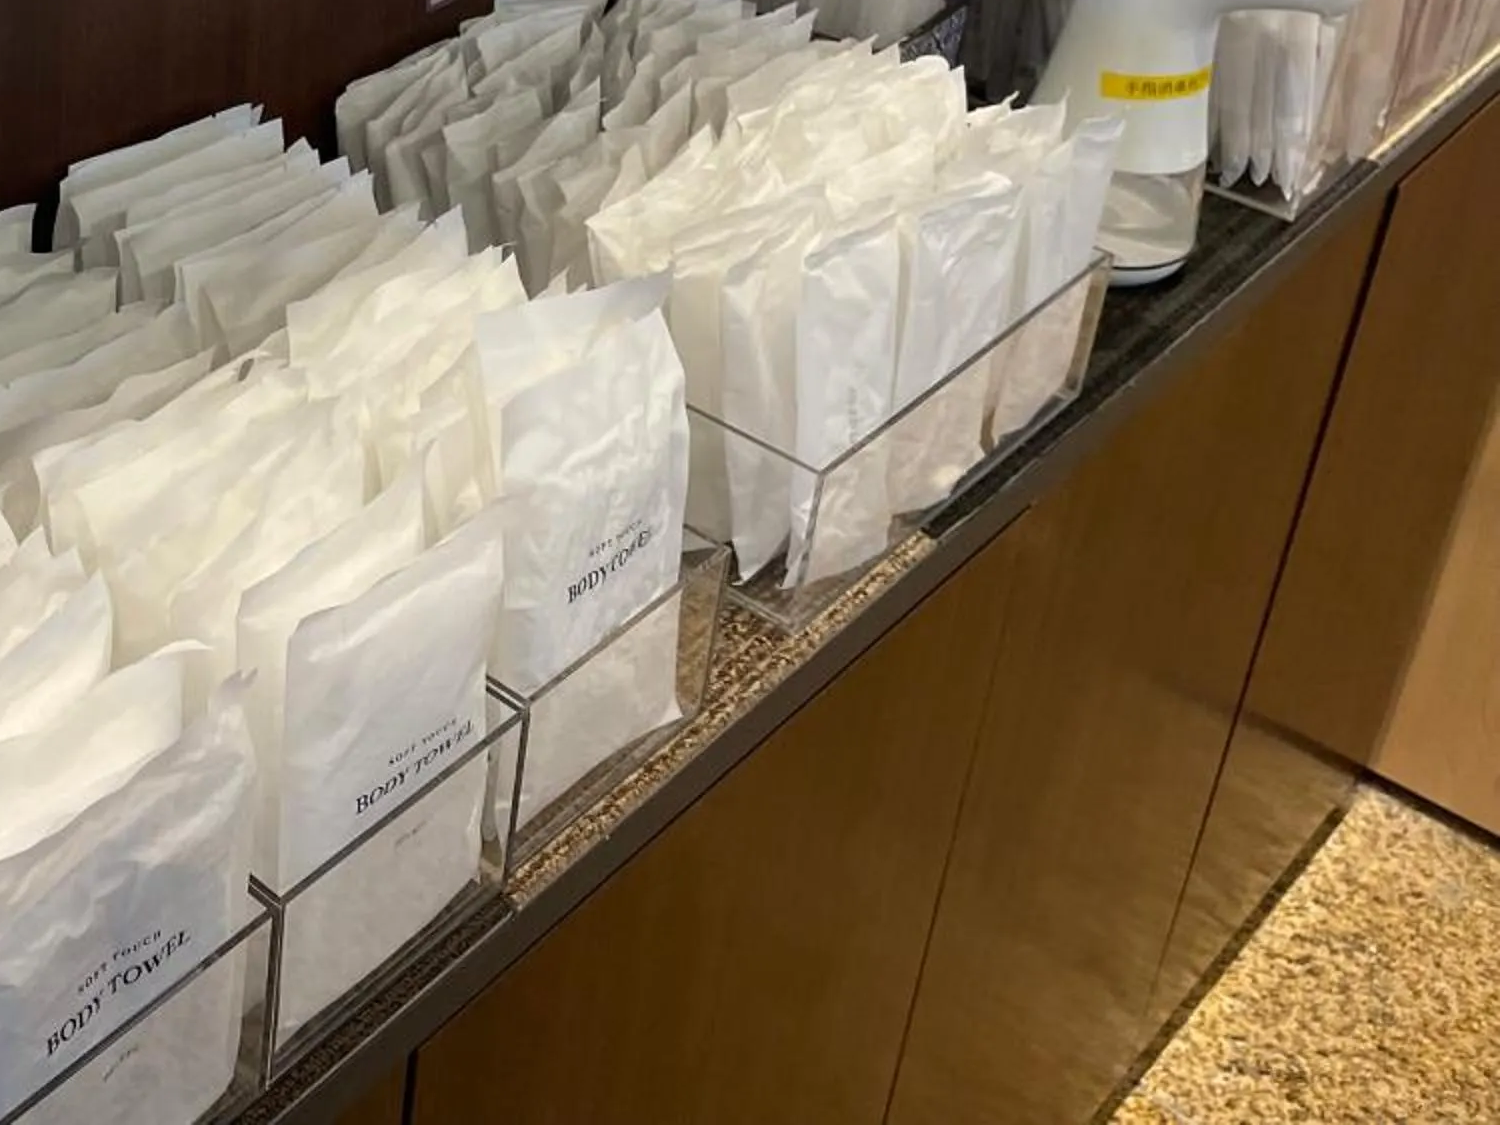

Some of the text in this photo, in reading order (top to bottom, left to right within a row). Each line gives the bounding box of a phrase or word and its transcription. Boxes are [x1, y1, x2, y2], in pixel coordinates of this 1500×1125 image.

[567, 563, 610, 604] BODY
[356, 766, 410, 815] BODY
[47, 930, 191, 1058] BODY TOWEL
